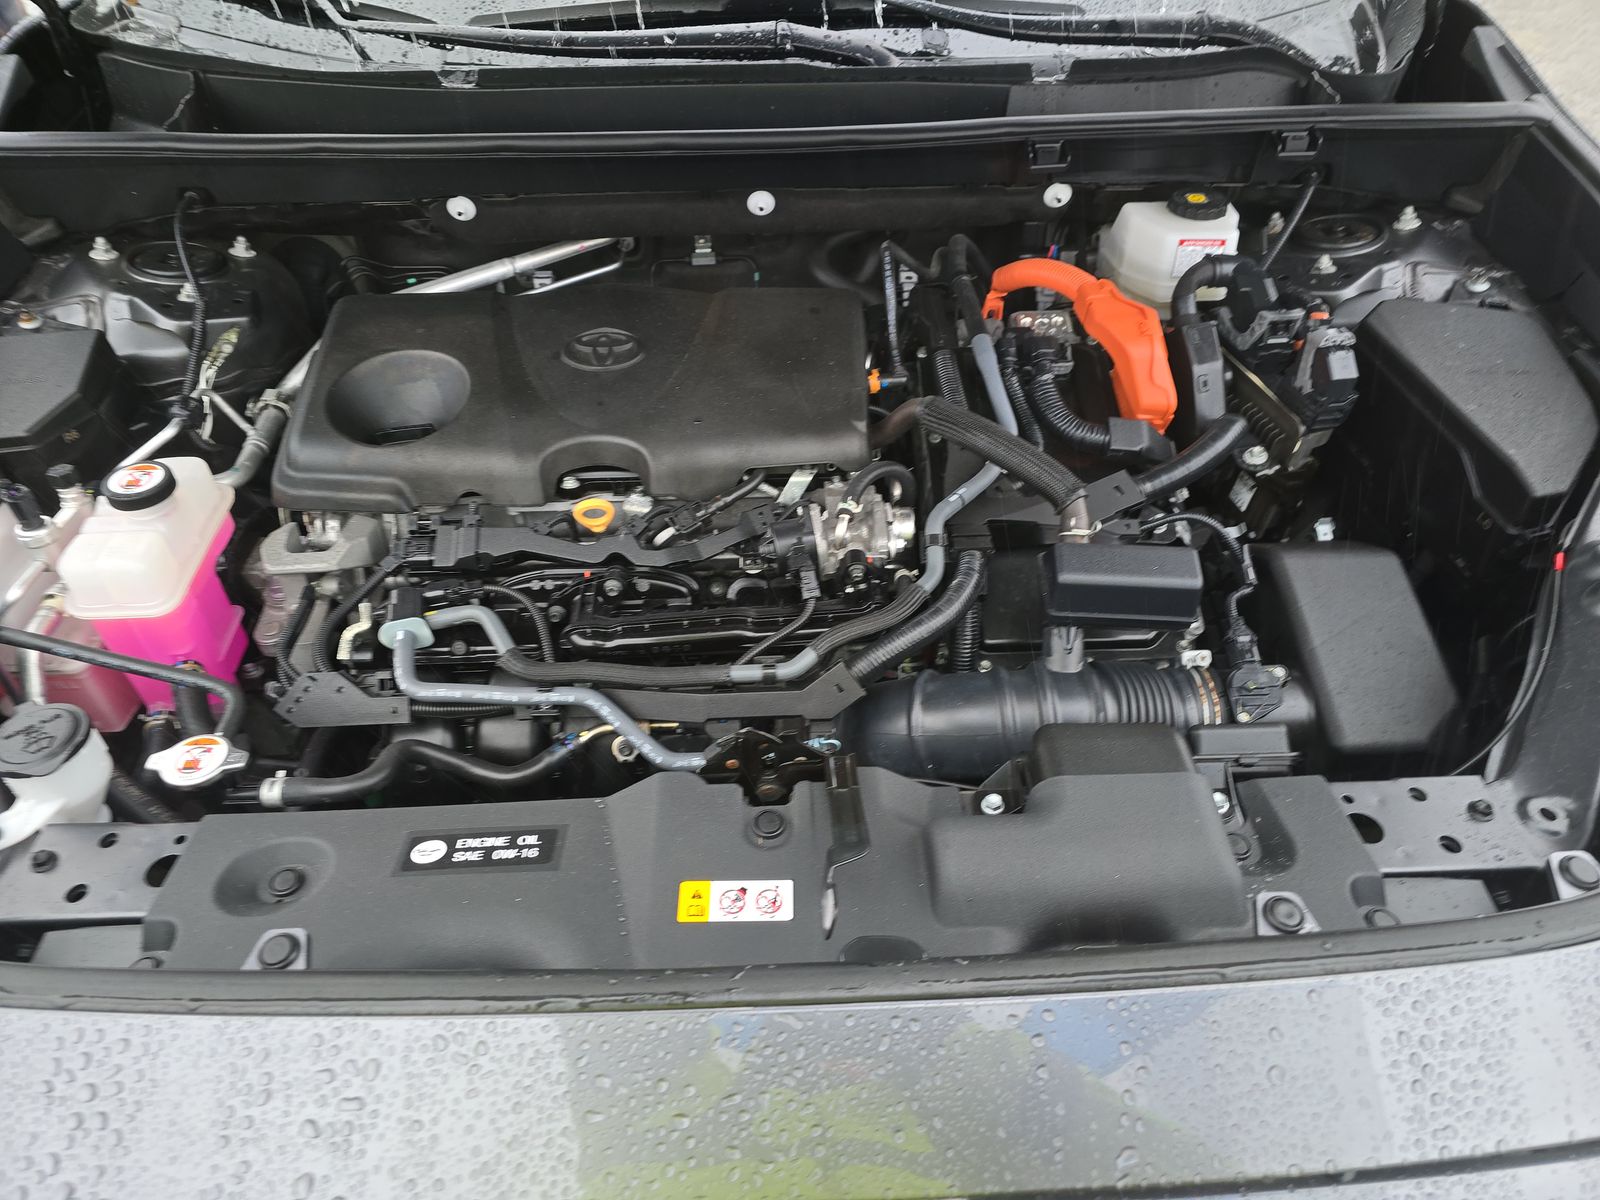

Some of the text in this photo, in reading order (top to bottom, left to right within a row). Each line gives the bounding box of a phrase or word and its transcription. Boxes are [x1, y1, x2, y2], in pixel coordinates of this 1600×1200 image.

[455, 835, 542, 848] ENGINE OIL
[451, 850, 485, 861] SAE
